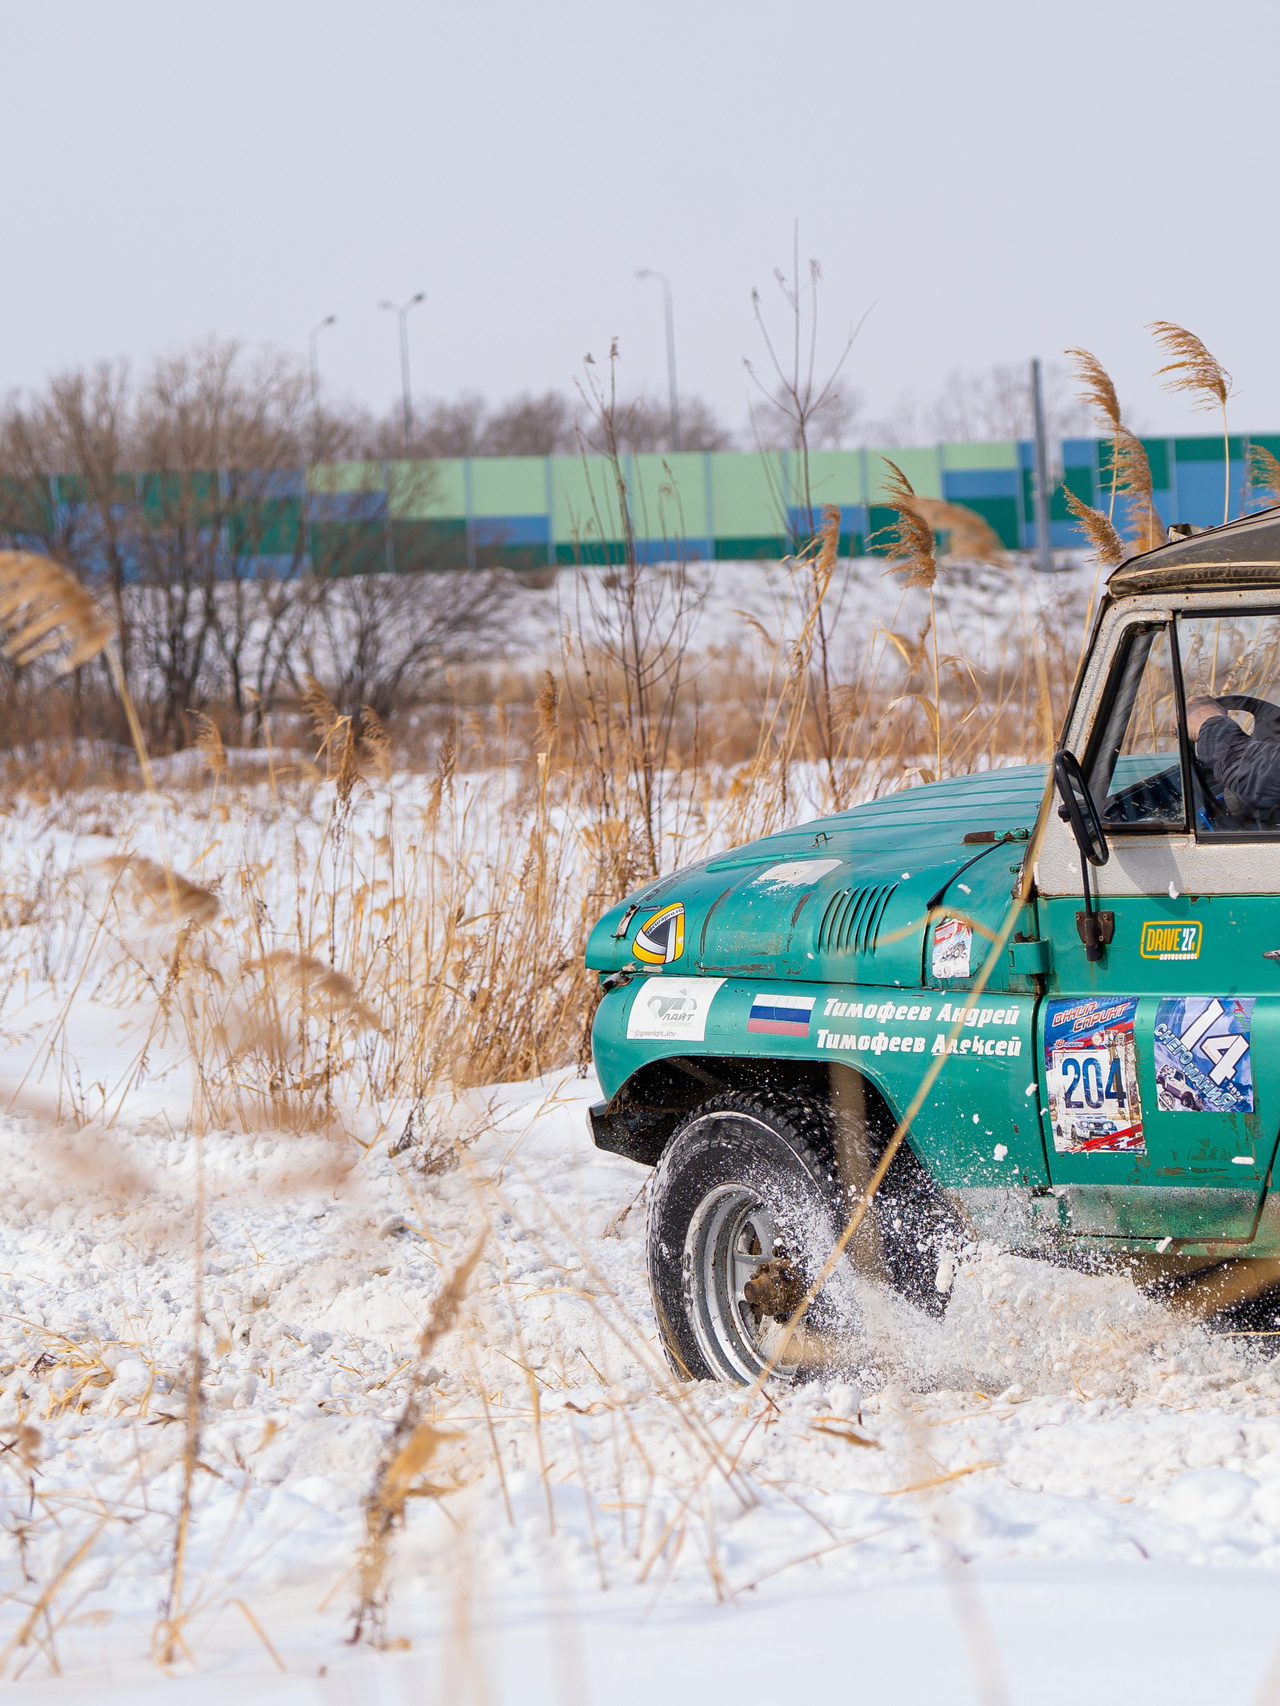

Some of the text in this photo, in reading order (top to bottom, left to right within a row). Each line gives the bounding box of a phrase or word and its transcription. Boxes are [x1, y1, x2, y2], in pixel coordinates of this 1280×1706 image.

[1146, 928, 1182, 951] DRIVE
[662, 1013, 695, 1021] ЛАЙТ
[823, 998, 1020, 1028] Тимофеев Андрей
[1052, 1001, 1098, 1027] ДЖИП
[1073, 1002, 1132, 1032] СПРИНТ
[816, 1029, 1022, 1056] Тимофеев Алексей
[1180, 996, 1250, 1088] 14
[1154, 1023, 1237, 1112] СНЕГОМАНИЯ
[1062, 1057, 1127, 1109] 204
